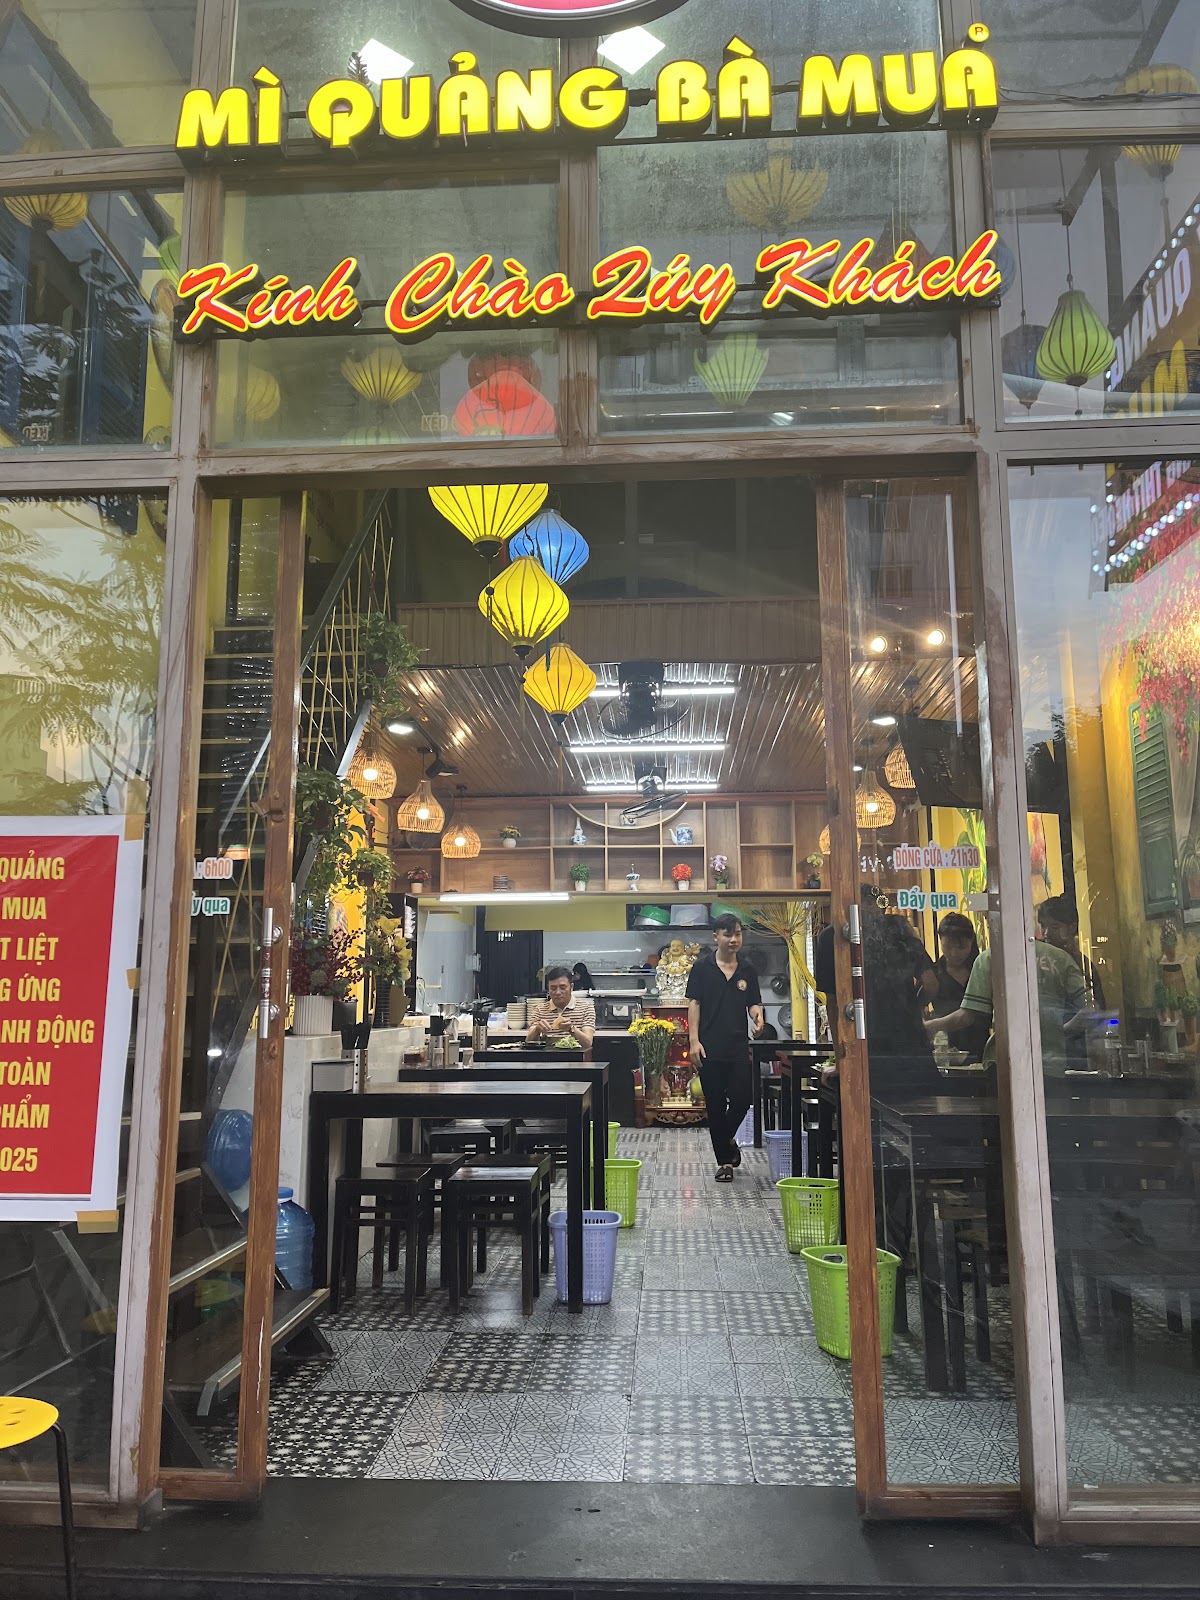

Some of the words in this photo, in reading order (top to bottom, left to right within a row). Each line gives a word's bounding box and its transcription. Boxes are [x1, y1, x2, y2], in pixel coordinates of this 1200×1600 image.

[177, 66, 281, 148] MÌ
[307, 51, 627, 148] QUẢNG
[657, 37, 770, 122] BÀ
[177, 257, 358, 334] Kính
[385, 252, 575, 334] Chào
[756, 230, 1001, 309] Khách
[0, 850, 65, 882] QUẢNG
[204, 859, 231, 877] 6h00
[896, 844, 921, 867] ĐÓNG
[951, 848, 979, 867] 21h30
[1, 897, 47, 920] MUA
[204, 899, 228, 914] qua
[899, 887, 926, 910] Đẩy
[930, 893, 957, 909] qua
[16, 932, 59, 966] LIỆT
[17, 973, 61, 1002] ỨNG
[36, 1014, 95, 1048] ĐỘNG
[0, 1056, 51, 1086] TOÀN
[0, 1094, 50, 1129] HẨM
